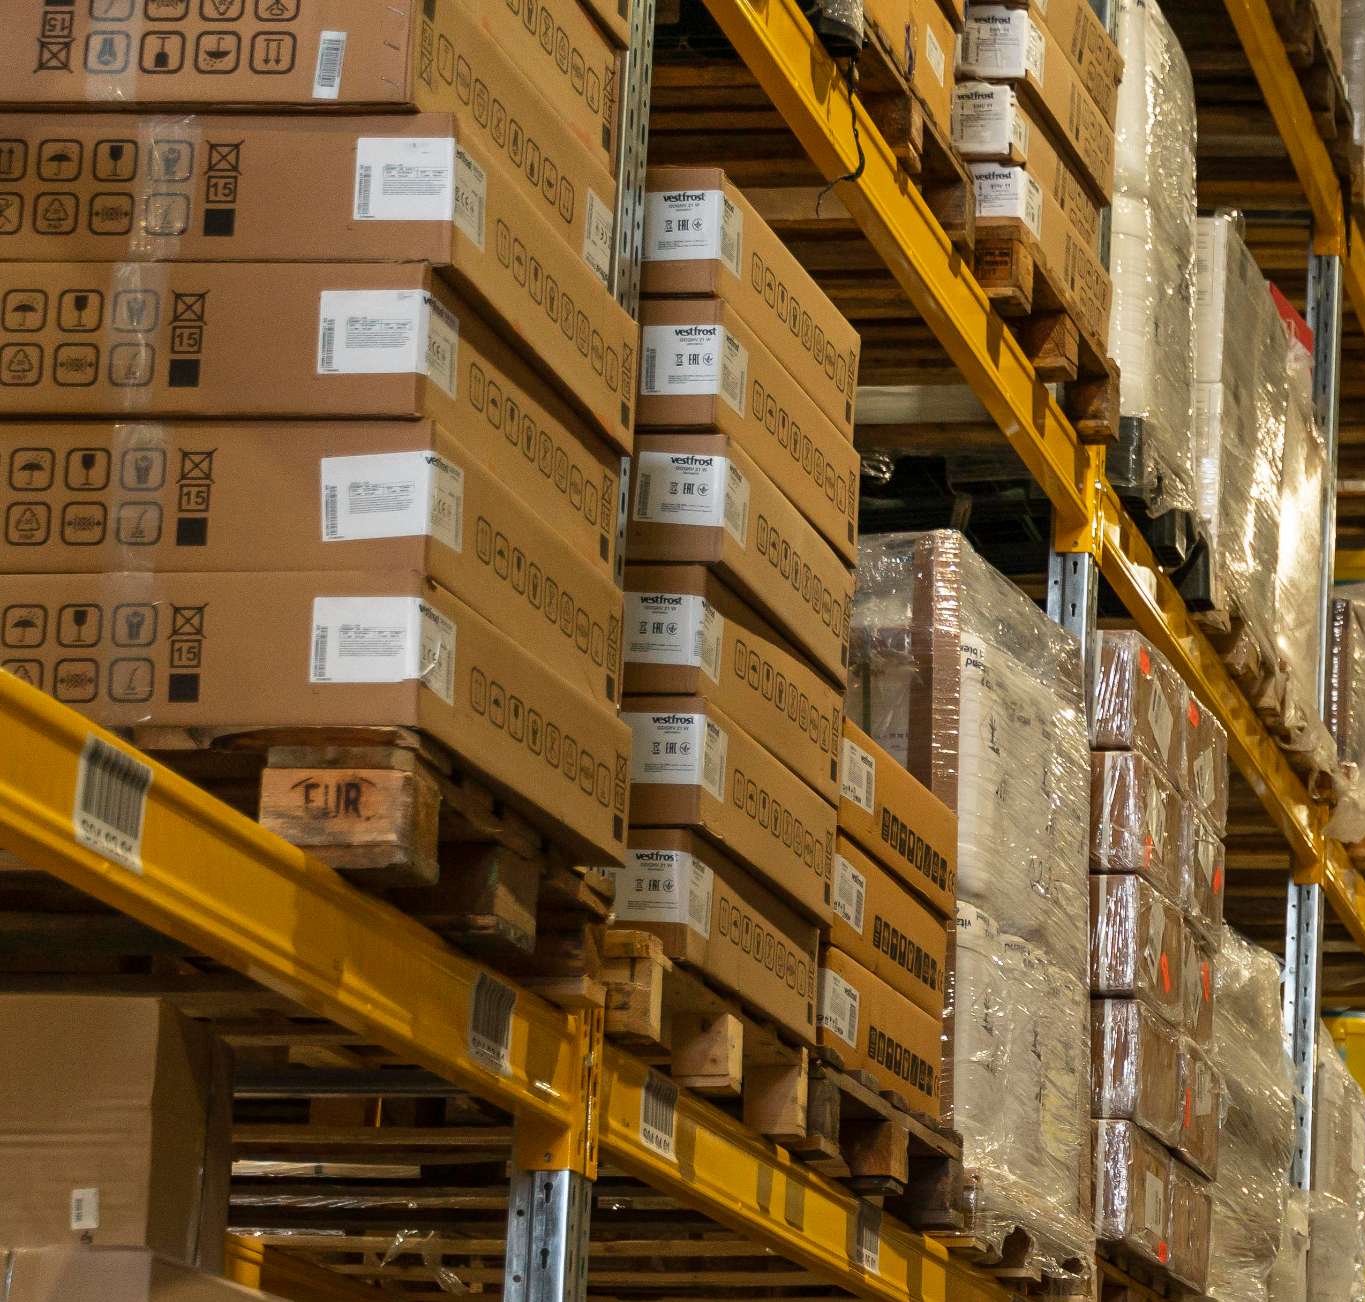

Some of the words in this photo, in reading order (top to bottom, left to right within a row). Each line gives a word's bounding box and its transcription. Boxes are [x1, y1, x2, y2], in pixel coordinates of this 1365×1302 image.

[46, 16, 71, 34] 15
[210, 181, 233, 197] 15
[663, 192, 706, 203] vestfrost
[675, 327, 717, 337] vestfrost
[176, 332, 199, 347] 15
[671, 456, 713, 466] vestfrost
[183, 490, 206, 505] 15
[641, 595, 682, 605] vestfrost
[176, 647, 198, 661] 15
[652, 716, 694, 724] vestfrost
